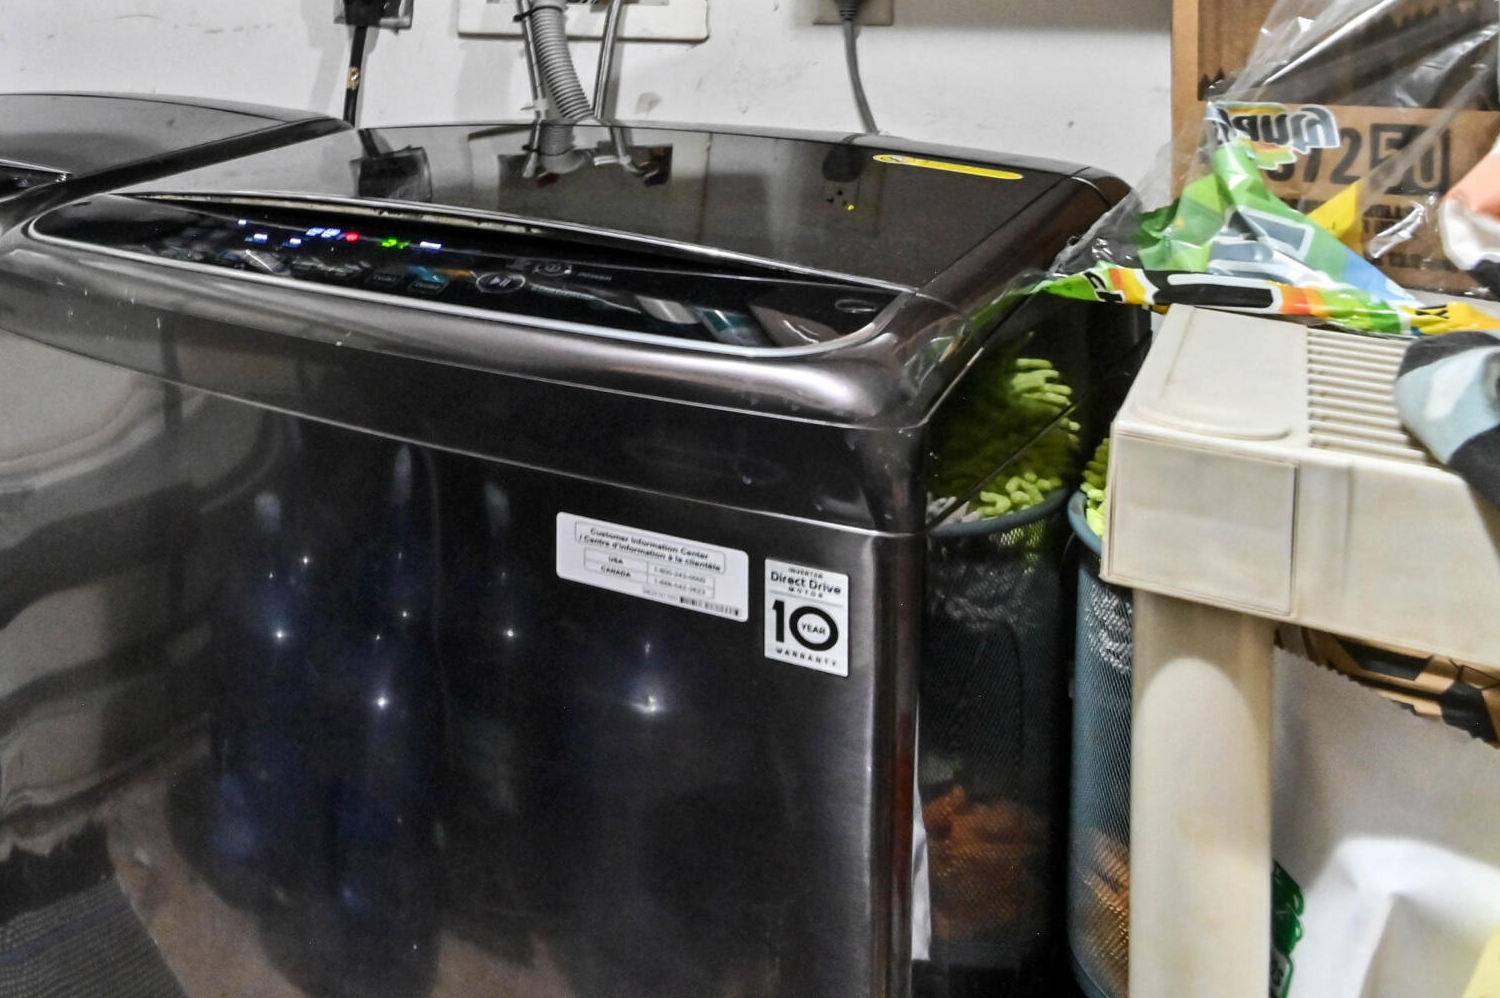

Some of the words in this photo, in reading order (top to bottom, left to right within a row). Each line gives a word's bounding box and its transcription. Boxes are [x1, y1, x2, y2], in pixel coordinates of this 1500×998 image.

[584, 535, 610, 547] Centre
[590, 527, 629, 542] Customer
[680, 547, 709, 560] Center
[608, 555, 624, 565] USA
[601, 566, 631, 579] CANADA
[771, 571, 806, 589] Direct
[809, 579, 841, 595] Drive
[772, 600, 839, 652] 10
[801, 622, 826, 635] YEAR
[775, 647, 837, 666] WARRANTY
